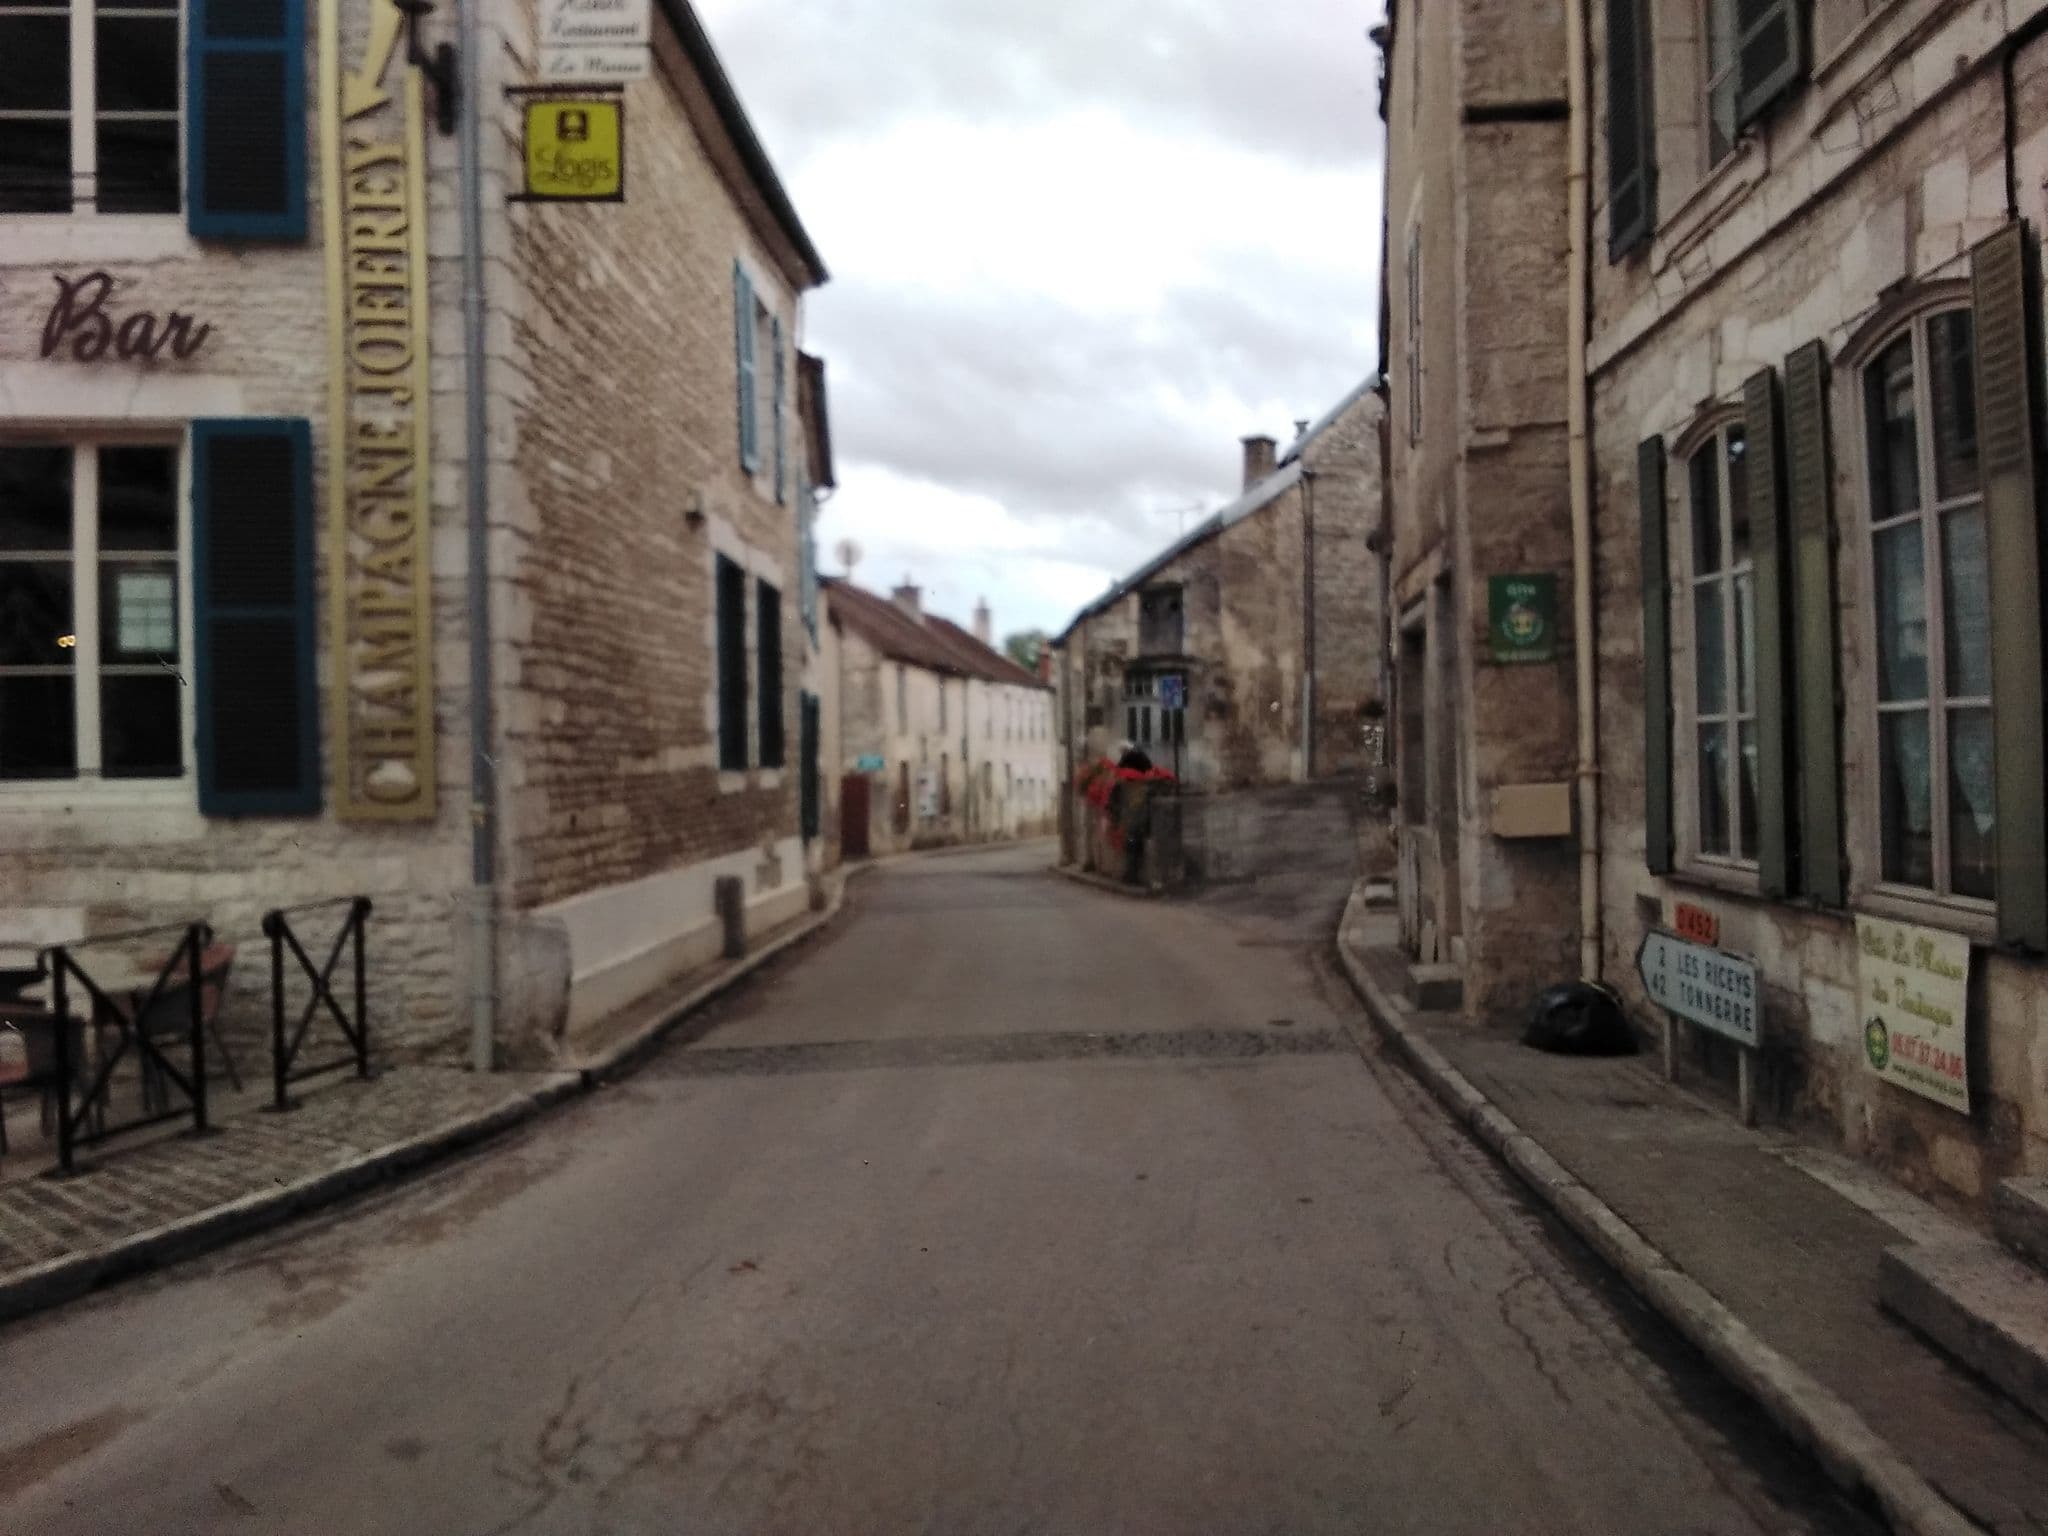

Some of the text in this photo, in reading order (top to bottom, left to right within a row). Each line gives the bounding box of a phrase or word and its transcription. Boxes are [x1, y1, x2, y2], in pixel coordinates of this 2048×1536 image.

[40, 268, 211, 361] Bar
[348, 421, 421, 805] CHAMPAGNE
[1678, 953, 1699, 979] LES
[1705, 960, 1752, 999] RICEYS
[1680, 981, 1752, 1032] TONNERRE
